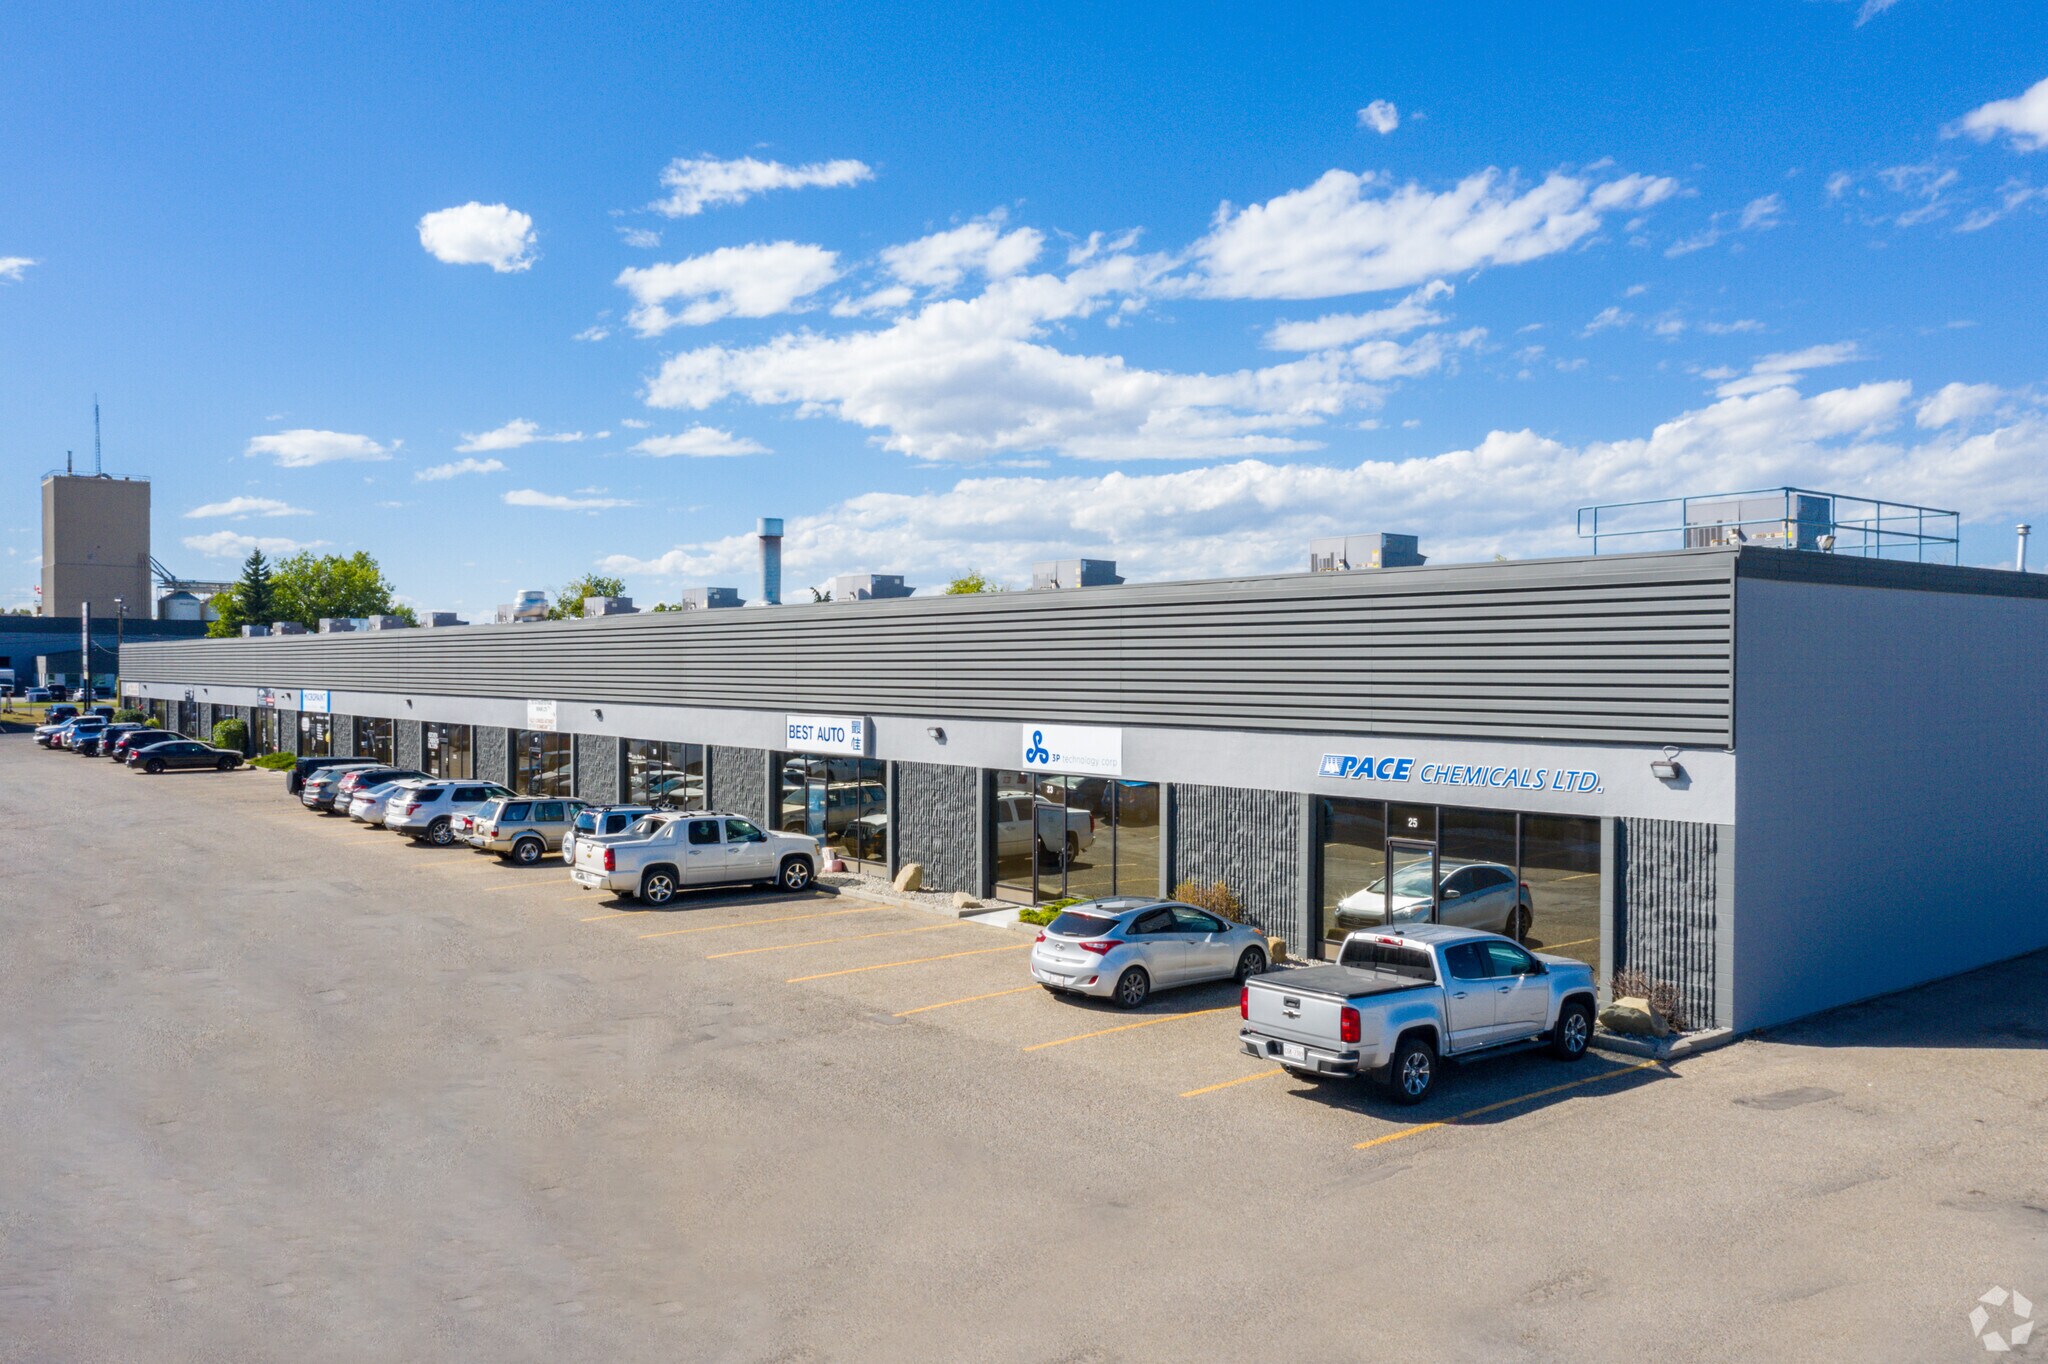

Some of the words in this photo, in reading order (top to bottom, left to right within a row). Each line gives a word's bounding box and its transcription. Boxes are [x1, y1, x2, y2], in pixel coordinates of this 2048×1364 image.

[789, 725, 814, 740] BEST
[817, 726, 845, 743] AUTO
[851, 720, 861, 750] 最佳
[1052, 754, 1060, 762] 3P
[1062, 755, 1099, 767] technology
[1101, 758, 1118, 767] corp
[1340, 755, 1415, 781] PACE
[1420, 763, 1548, 790] CHEMICALS
[1551, 769, 1603, 792] LTD.
[1046, 785, 1054, 794] 23
[1408, 817, 1418, 828] 25
